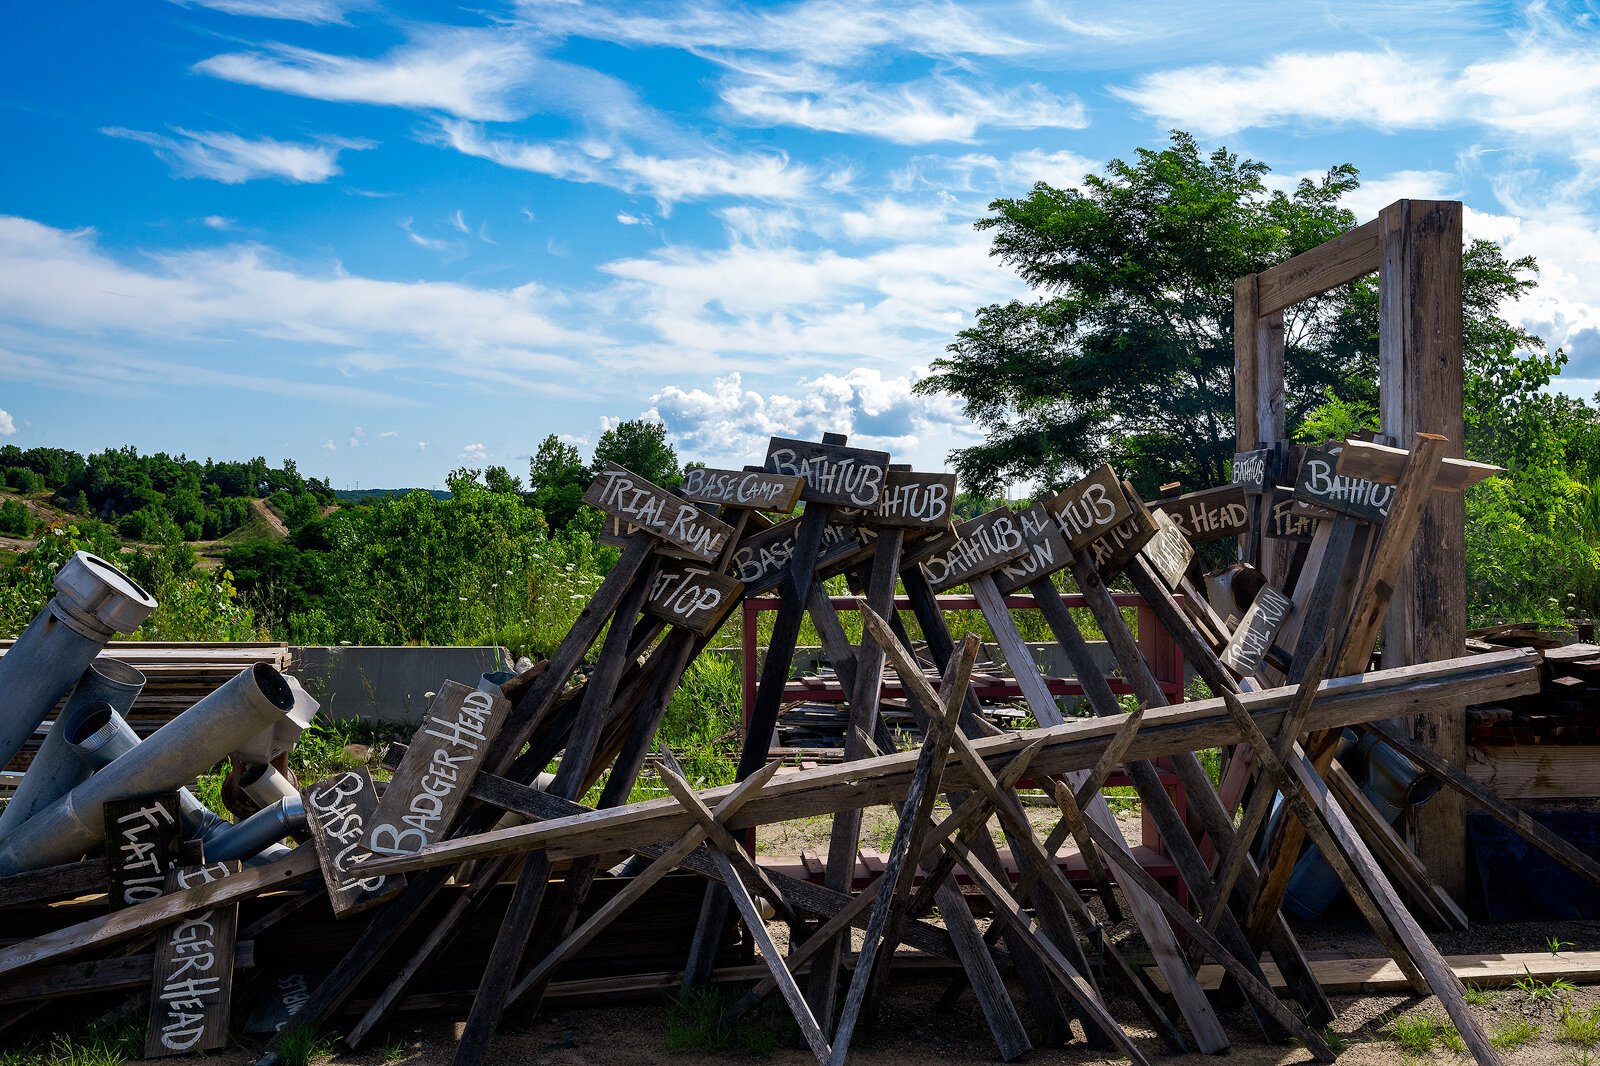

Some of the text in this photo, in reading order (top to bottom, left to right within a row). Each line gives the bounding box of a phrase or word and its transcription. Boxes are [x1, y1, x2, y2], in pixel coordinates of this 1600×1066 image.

[682, 469, 784, 503] BASE CAMP
[770, 448, 883, 506] BATHTUB
[1232, 455, 1265, 485] BATHTUB
[1304, 459, 1397, 517] BATHTU
[598, 471, 667, 527] TRIAL
[668, 504, 721, 556] RUN
[839, 483, 948, 522] HTUB
[1054, 483, 1116, 540] HTUB
[1189, 502, 1248, 536] HEAD
[919, 517, 1022, 584] BATHTUB
[663, 567, 721, 618] TOP
[1227, 587, 1290, 671] TRIAL RUN
[370, 690, 494, 856] BADGER HEAD
[309, 771, 386, 892] BASE CAP
[160, 976, 221, 1051] HEAD
